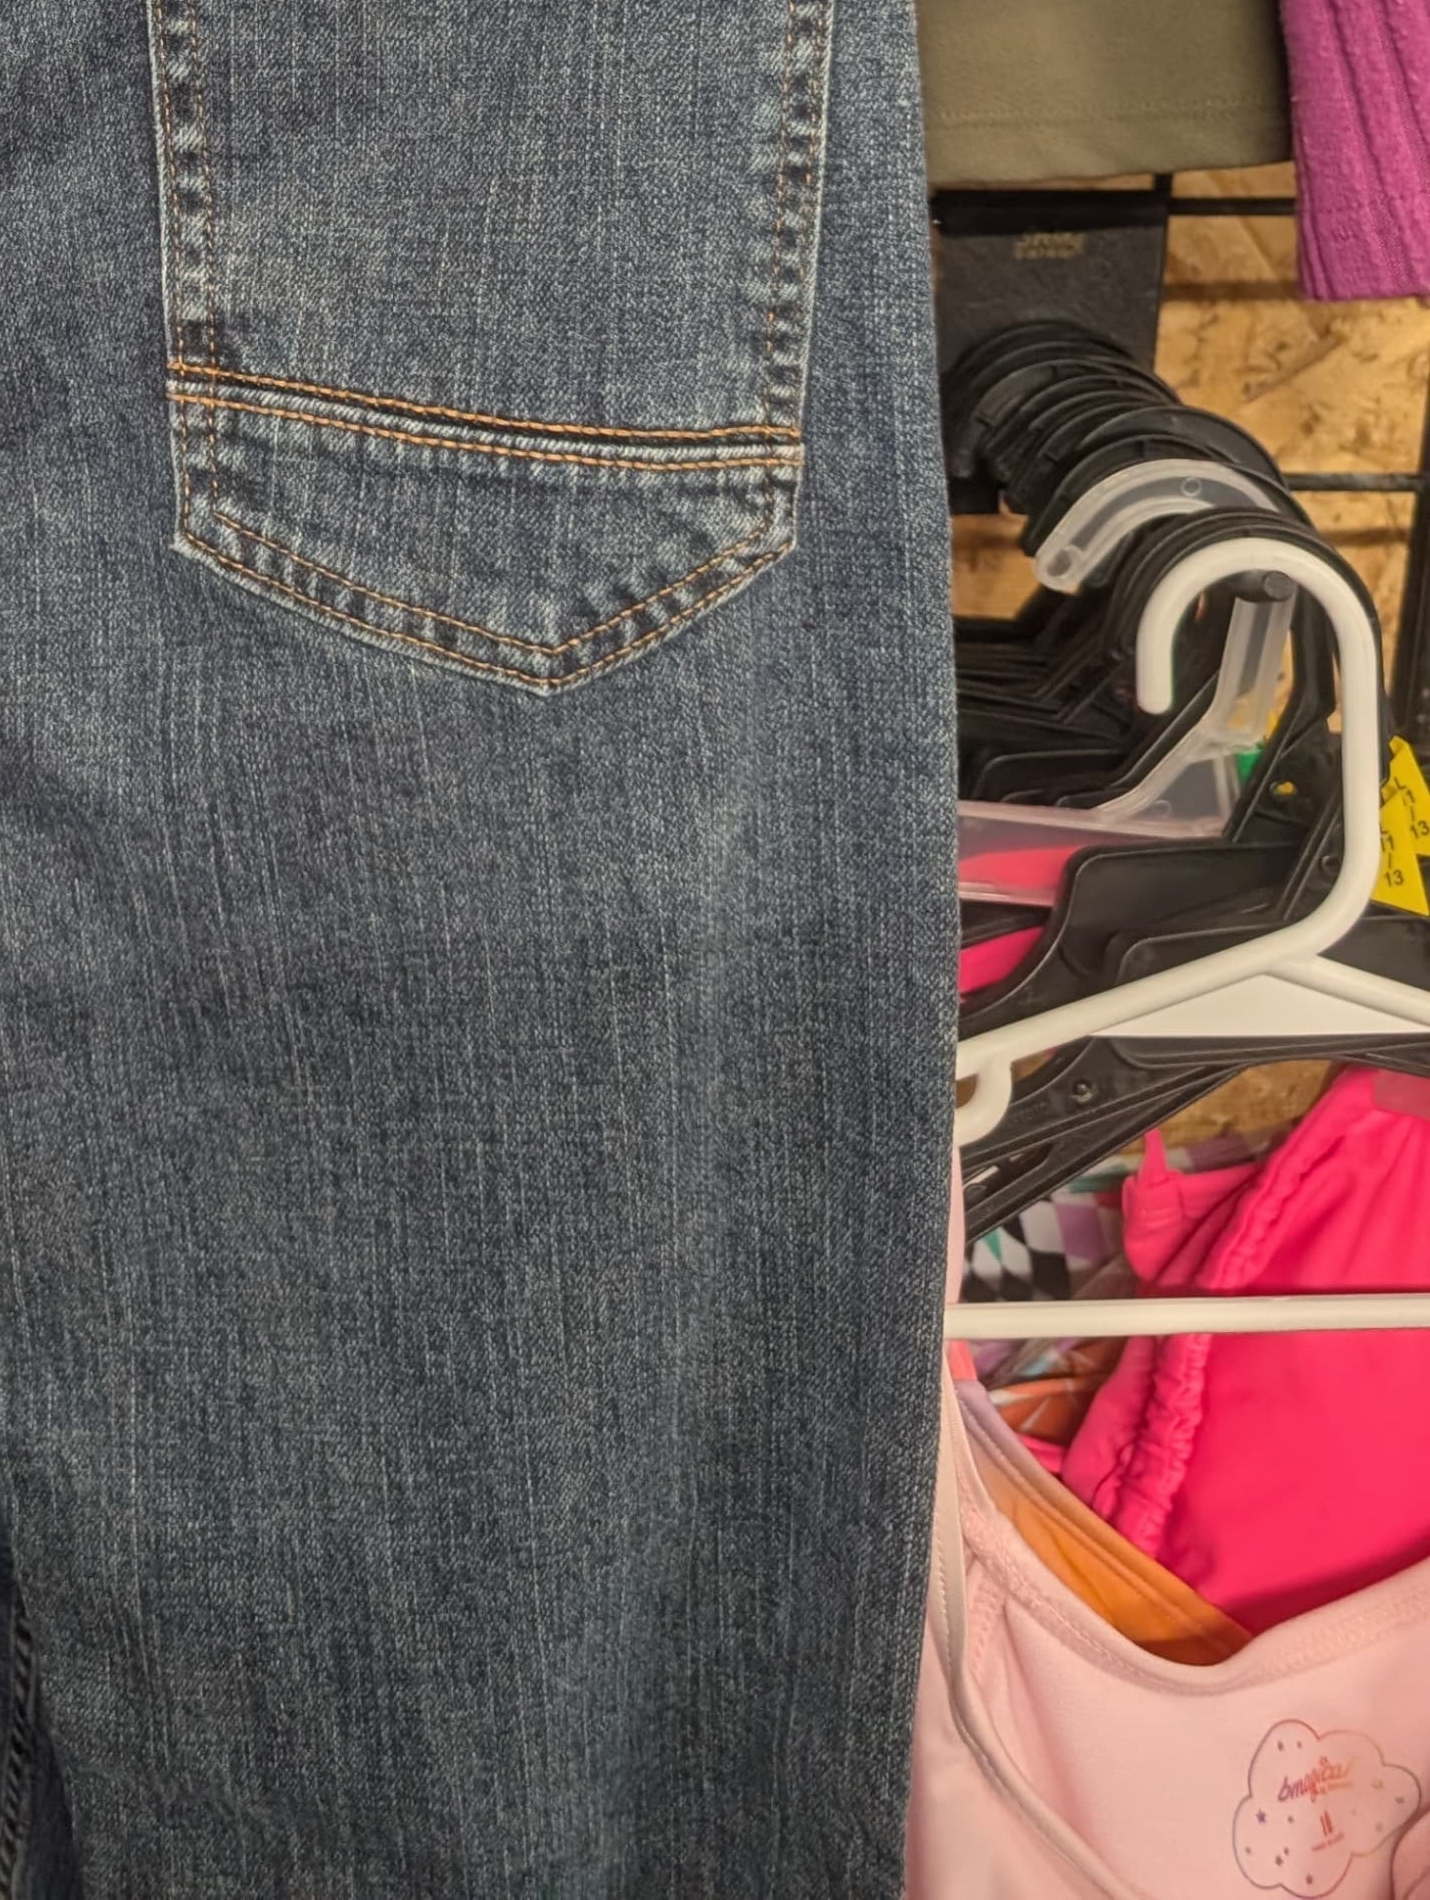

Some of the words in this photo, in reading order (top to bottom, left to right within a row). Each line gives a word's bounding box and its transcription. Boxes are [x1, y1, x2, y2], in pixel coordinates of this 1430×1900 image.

[1393, 776, 1407, 790] L
[1410, 819, 1430, 839] 13
[1383, 868, 1404, 888] 13
